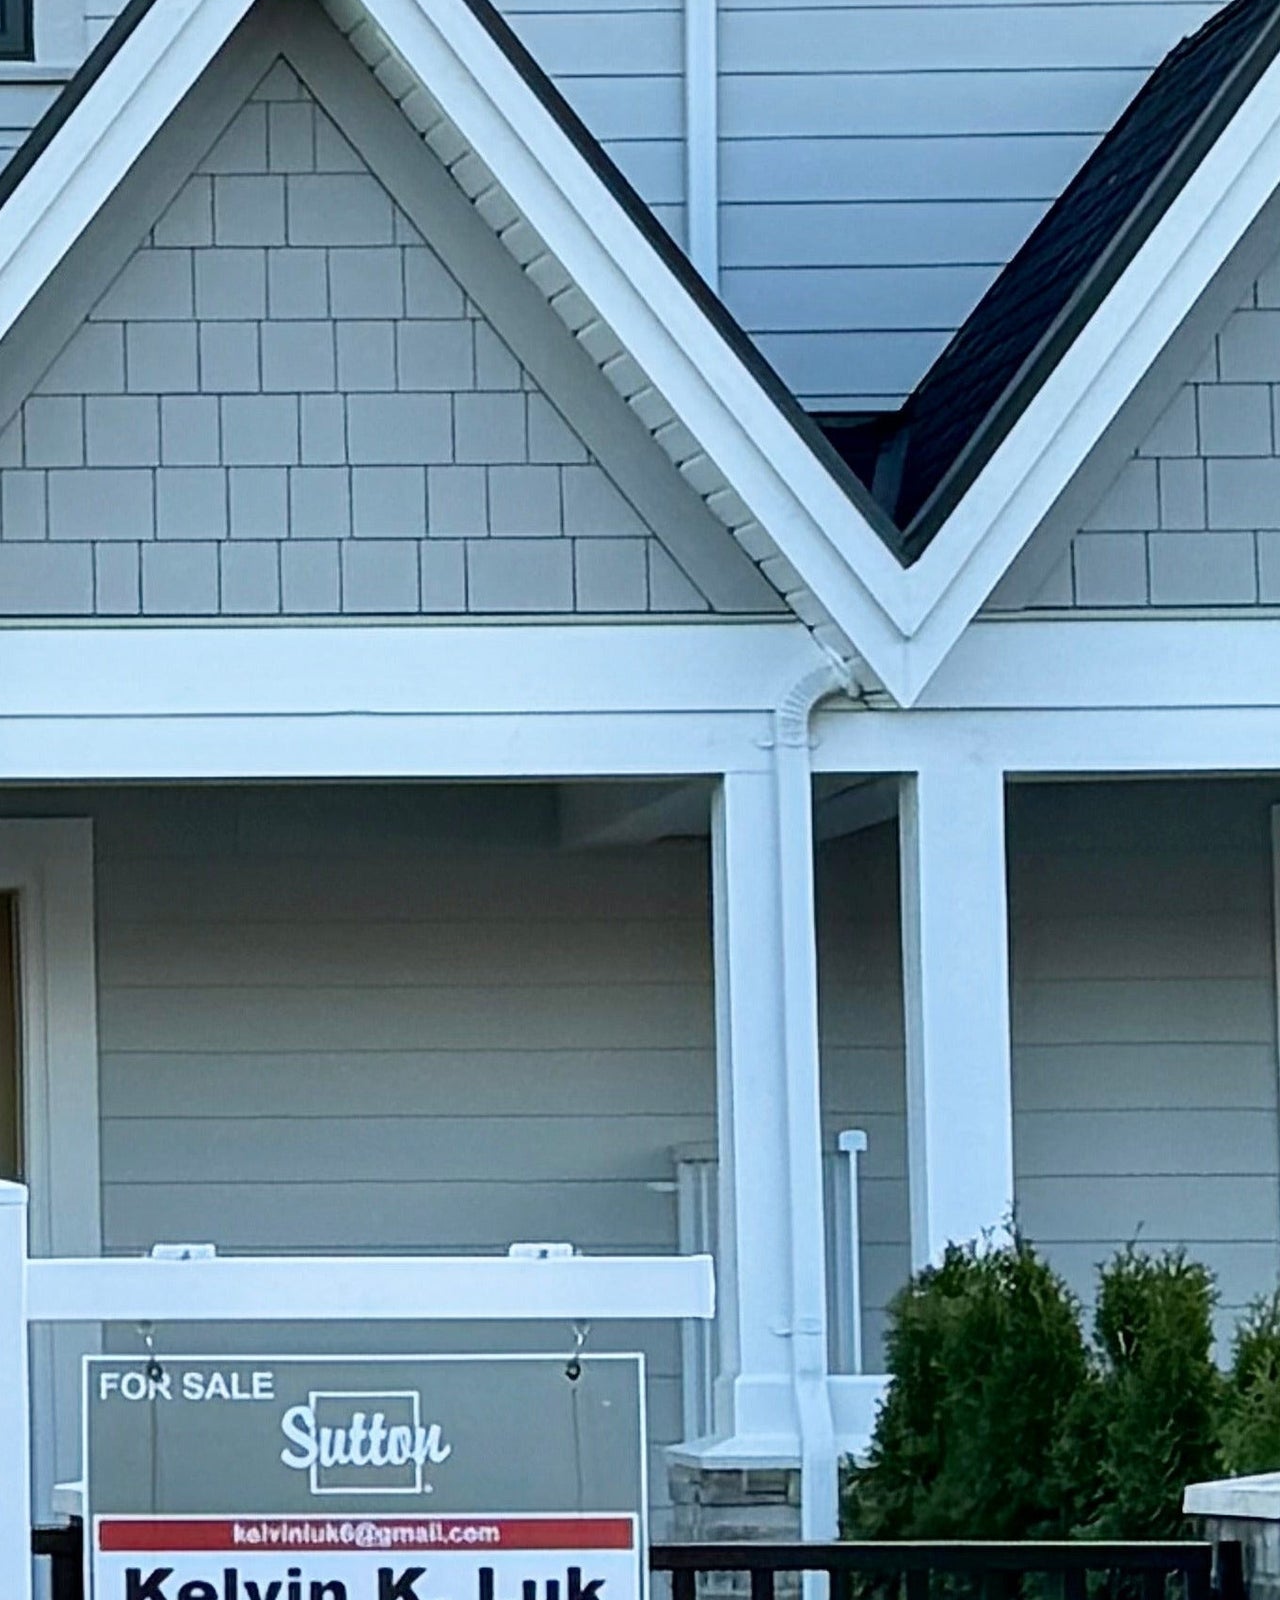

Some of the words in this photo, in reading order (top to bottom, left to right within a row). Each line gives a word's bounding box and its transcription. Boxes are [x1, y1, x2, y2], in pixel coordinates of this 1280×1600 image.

[100, 1371, 172, 1401] FOR
[182, 1371, 275, 1401] SALE
[281, 1405, 451, 1470] Sutton
